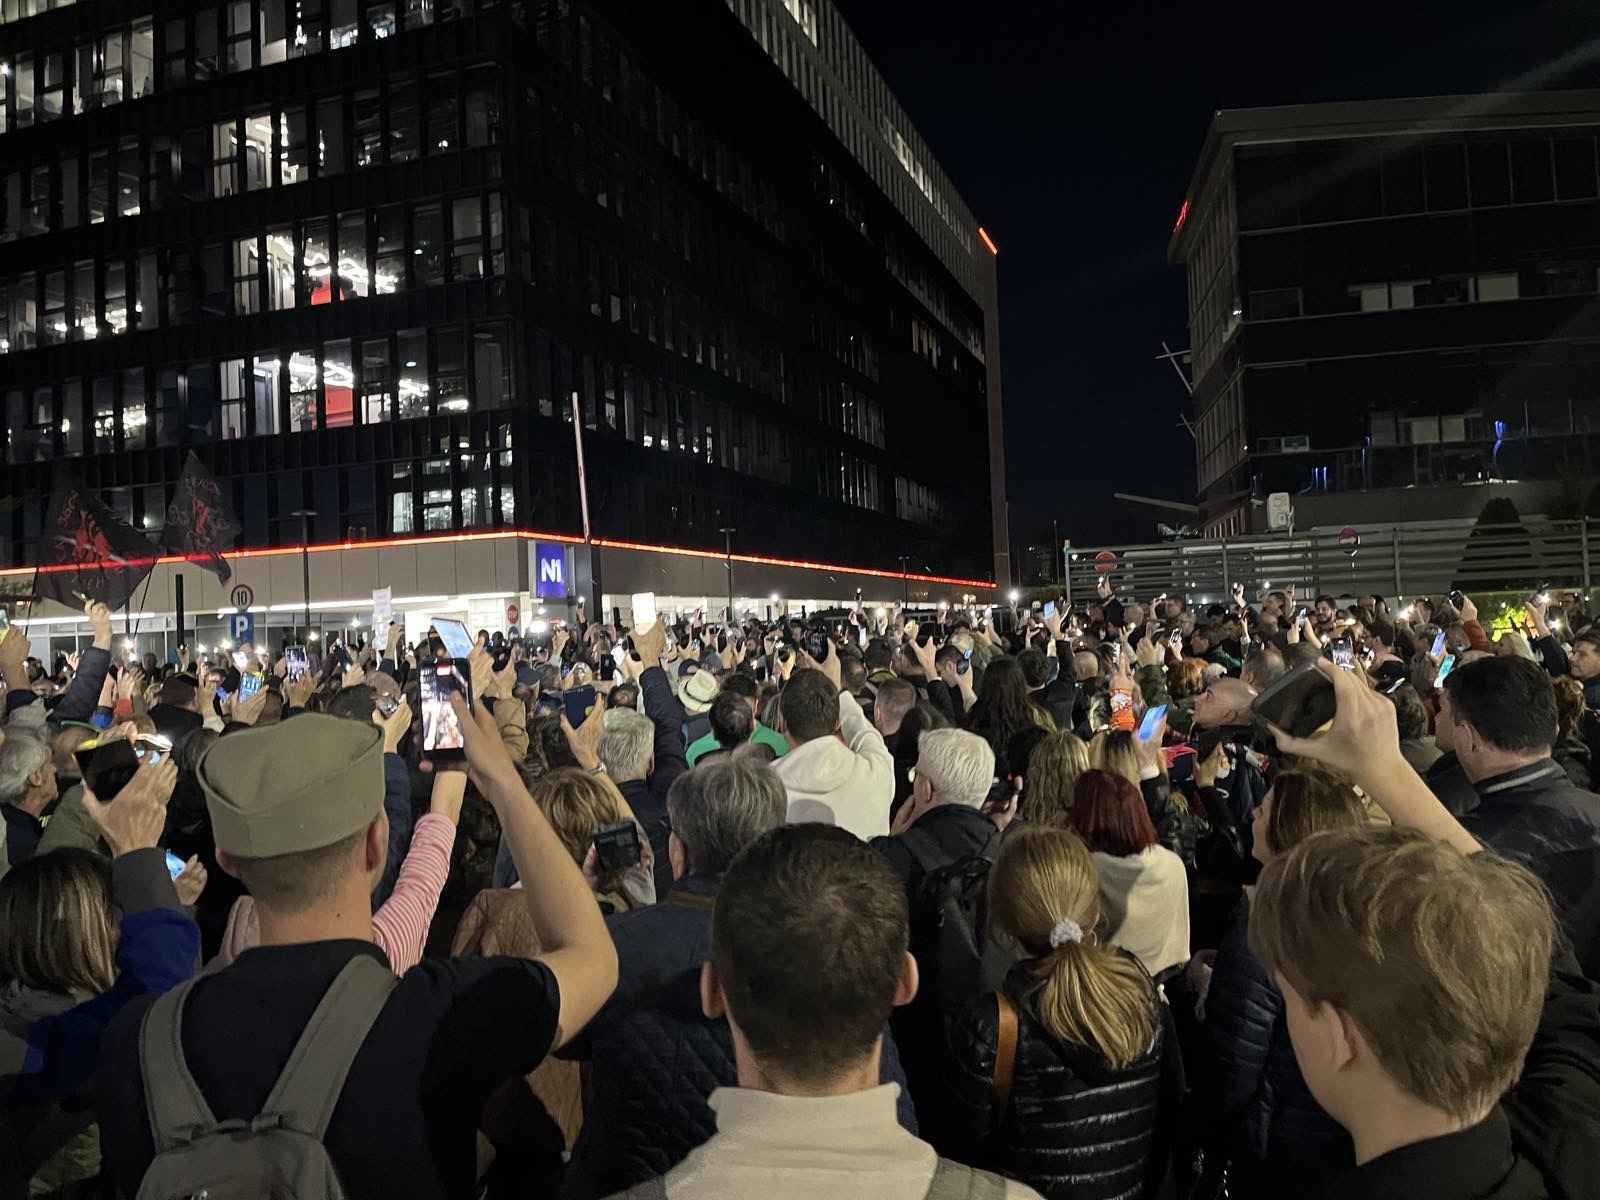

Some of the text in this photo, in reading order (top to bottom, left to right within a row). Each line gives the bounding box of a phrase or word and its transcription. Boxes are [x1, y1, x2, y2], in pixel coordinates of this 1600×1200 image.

[541, 558, 562, 582] N1
[237, 591, 247, 605] 10
[235, 616, 248, 638] P
